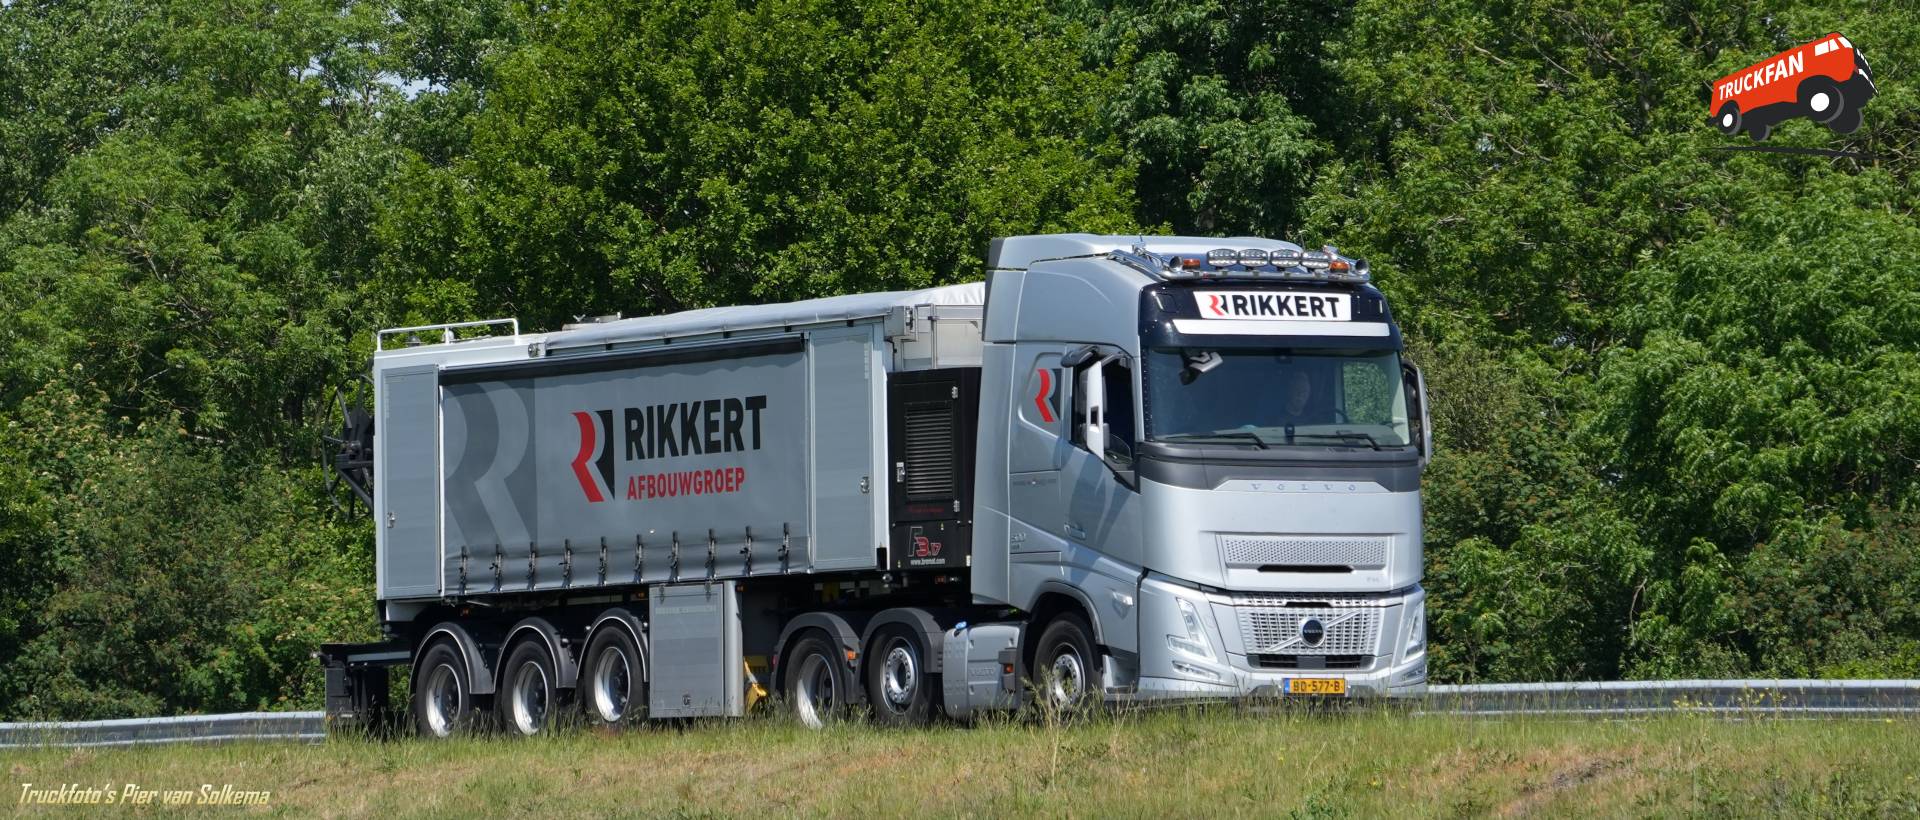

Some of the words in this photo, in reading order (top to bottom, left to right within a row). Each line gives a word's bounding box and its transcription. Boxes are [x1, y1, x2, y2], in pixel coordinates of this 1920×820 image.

[1231, 294, 1340, 318] RIKKERT
[624, 395, 767, 461] RIKKERT
[627, 467, 745, 500] AFBOUWGROEP
[1251, 483, 1356, 491] VOLVO
